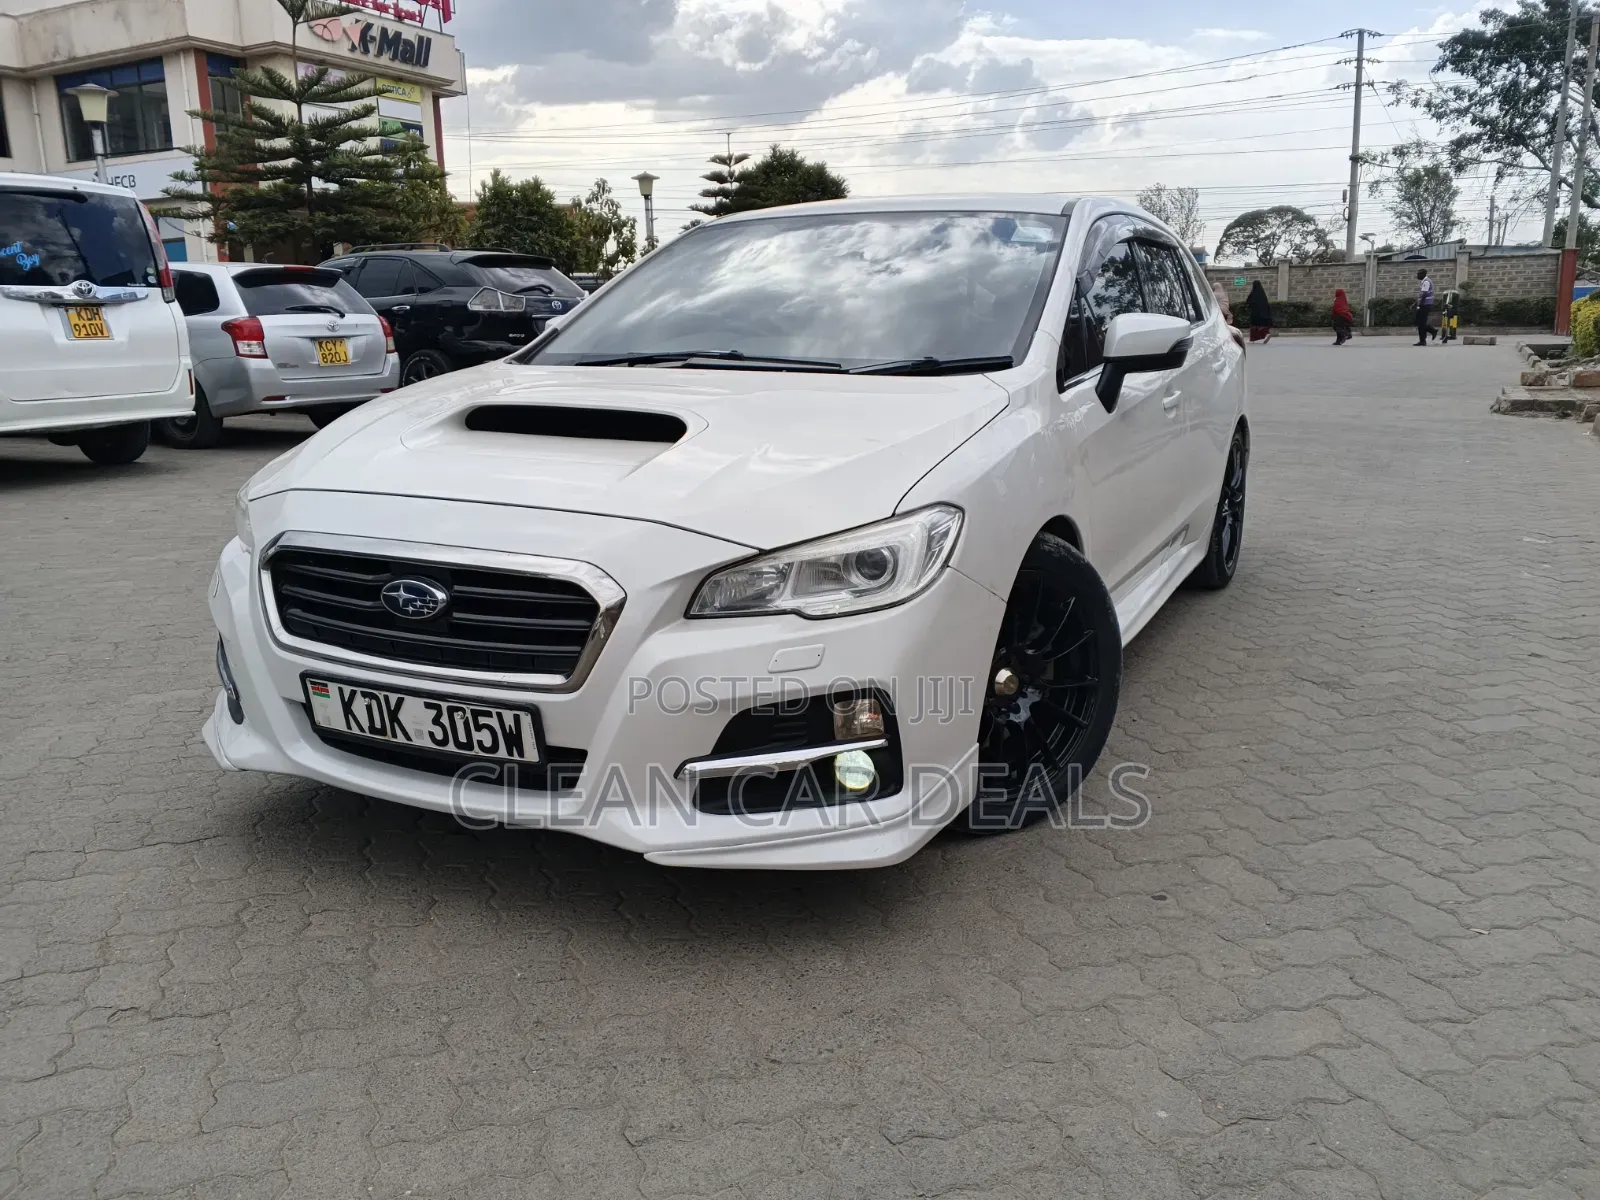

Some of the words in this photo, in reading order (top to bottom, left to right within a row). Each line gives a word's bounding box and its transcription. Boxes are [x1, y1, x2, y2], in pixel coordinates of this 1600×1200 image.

[76, 307, 102, 321] KDH
[73, 323, 104, 337] 910V
[319, 339, 338, 352] KCY
[321, 351, 348, 364] 820J
[338, 686, 413, 742] KDK
[423, 701, 525, 759] 305W
